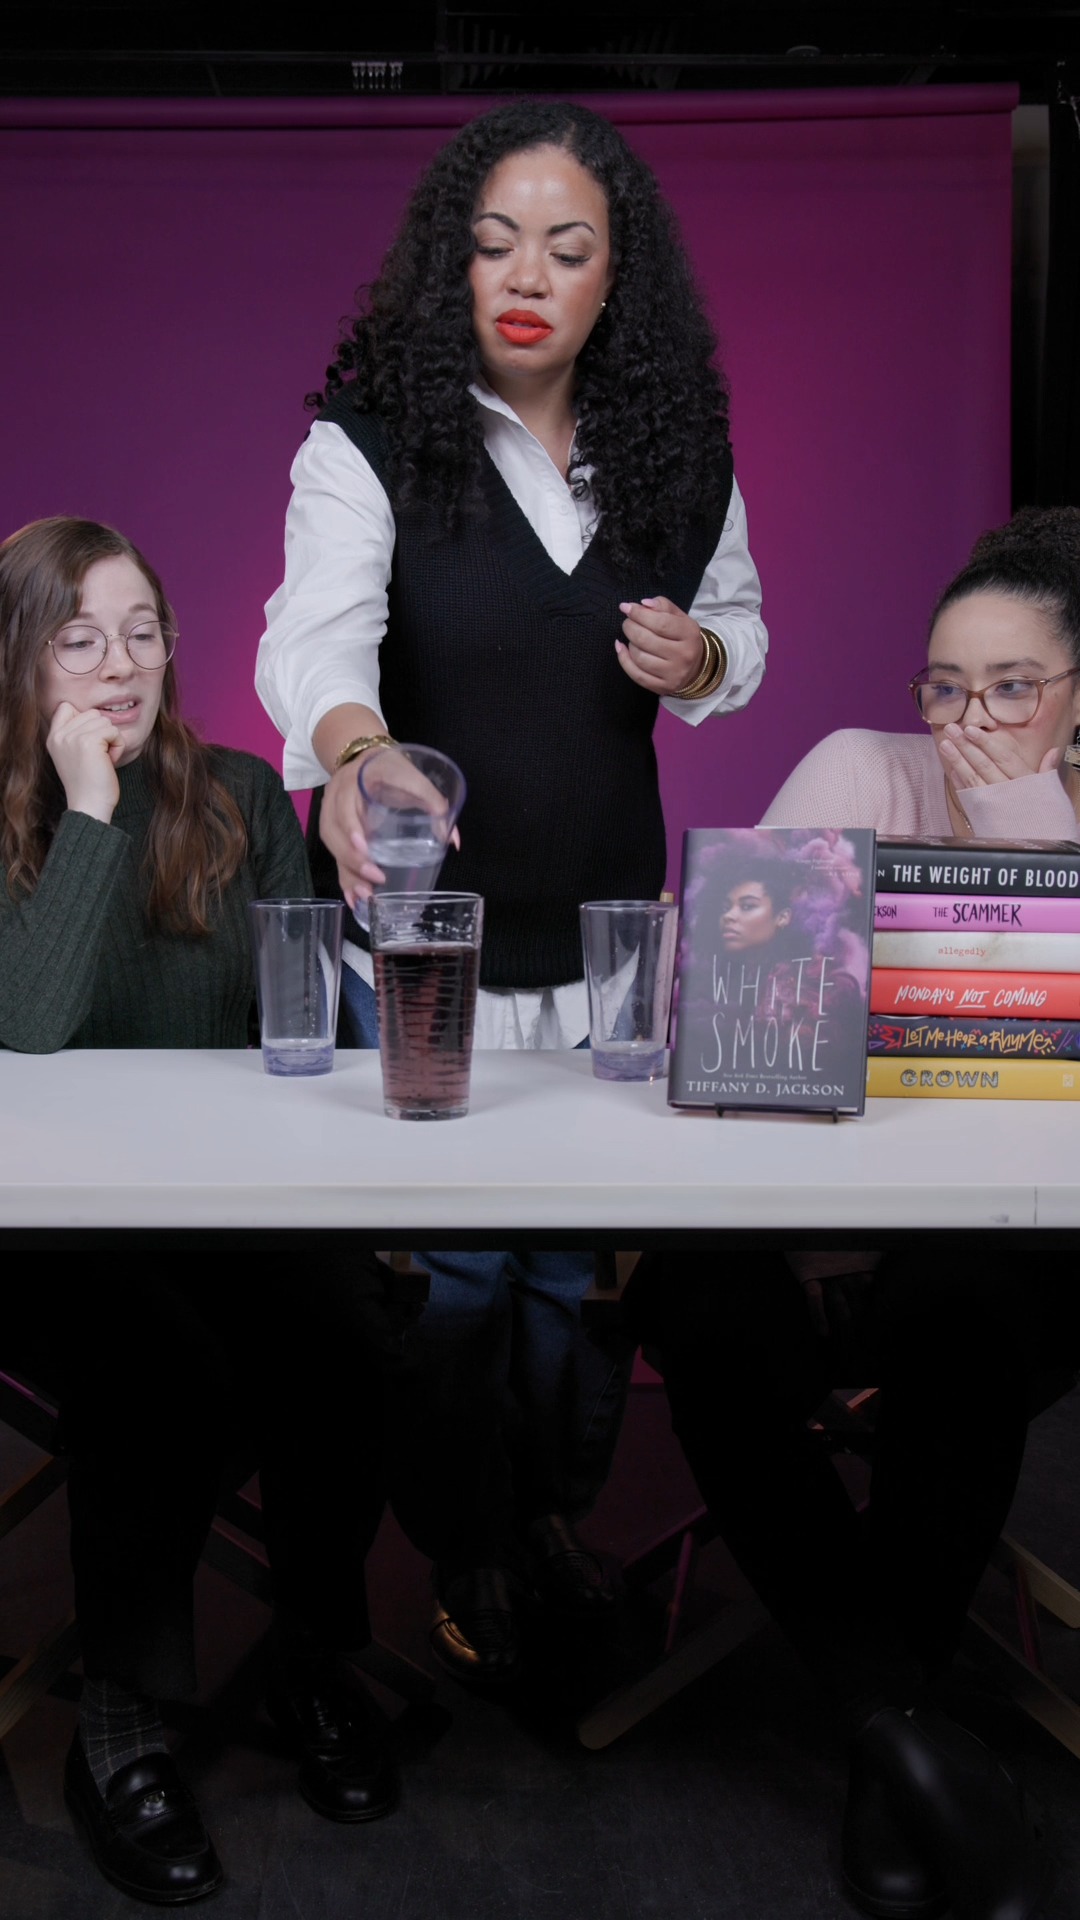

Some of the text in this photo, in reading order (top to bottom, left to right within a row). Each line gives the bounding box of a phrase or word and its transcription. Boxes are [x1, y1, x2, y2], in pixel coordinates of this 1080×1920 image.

[893, 865, 922, 883] THE
[929, 866, 991, 885] WEIGHT
[998, 868, 1018, 886] OF
[1025, 869, 1079, 888] BLOOD
[932, 906, 948, 918] THE
[938, 946, 986, 958] allegedly
[712, 954, 835, 1016] WHITE
[959, 988, 990, 1006] NOT
[993, 987, 1047, 1008] COMING
[700, 1012, 830, 1073] SMOKE
[901, 1069, 999, 1088] GROWN
[686, 1081, 844, 1097] TIFFANY D. JACKSON
